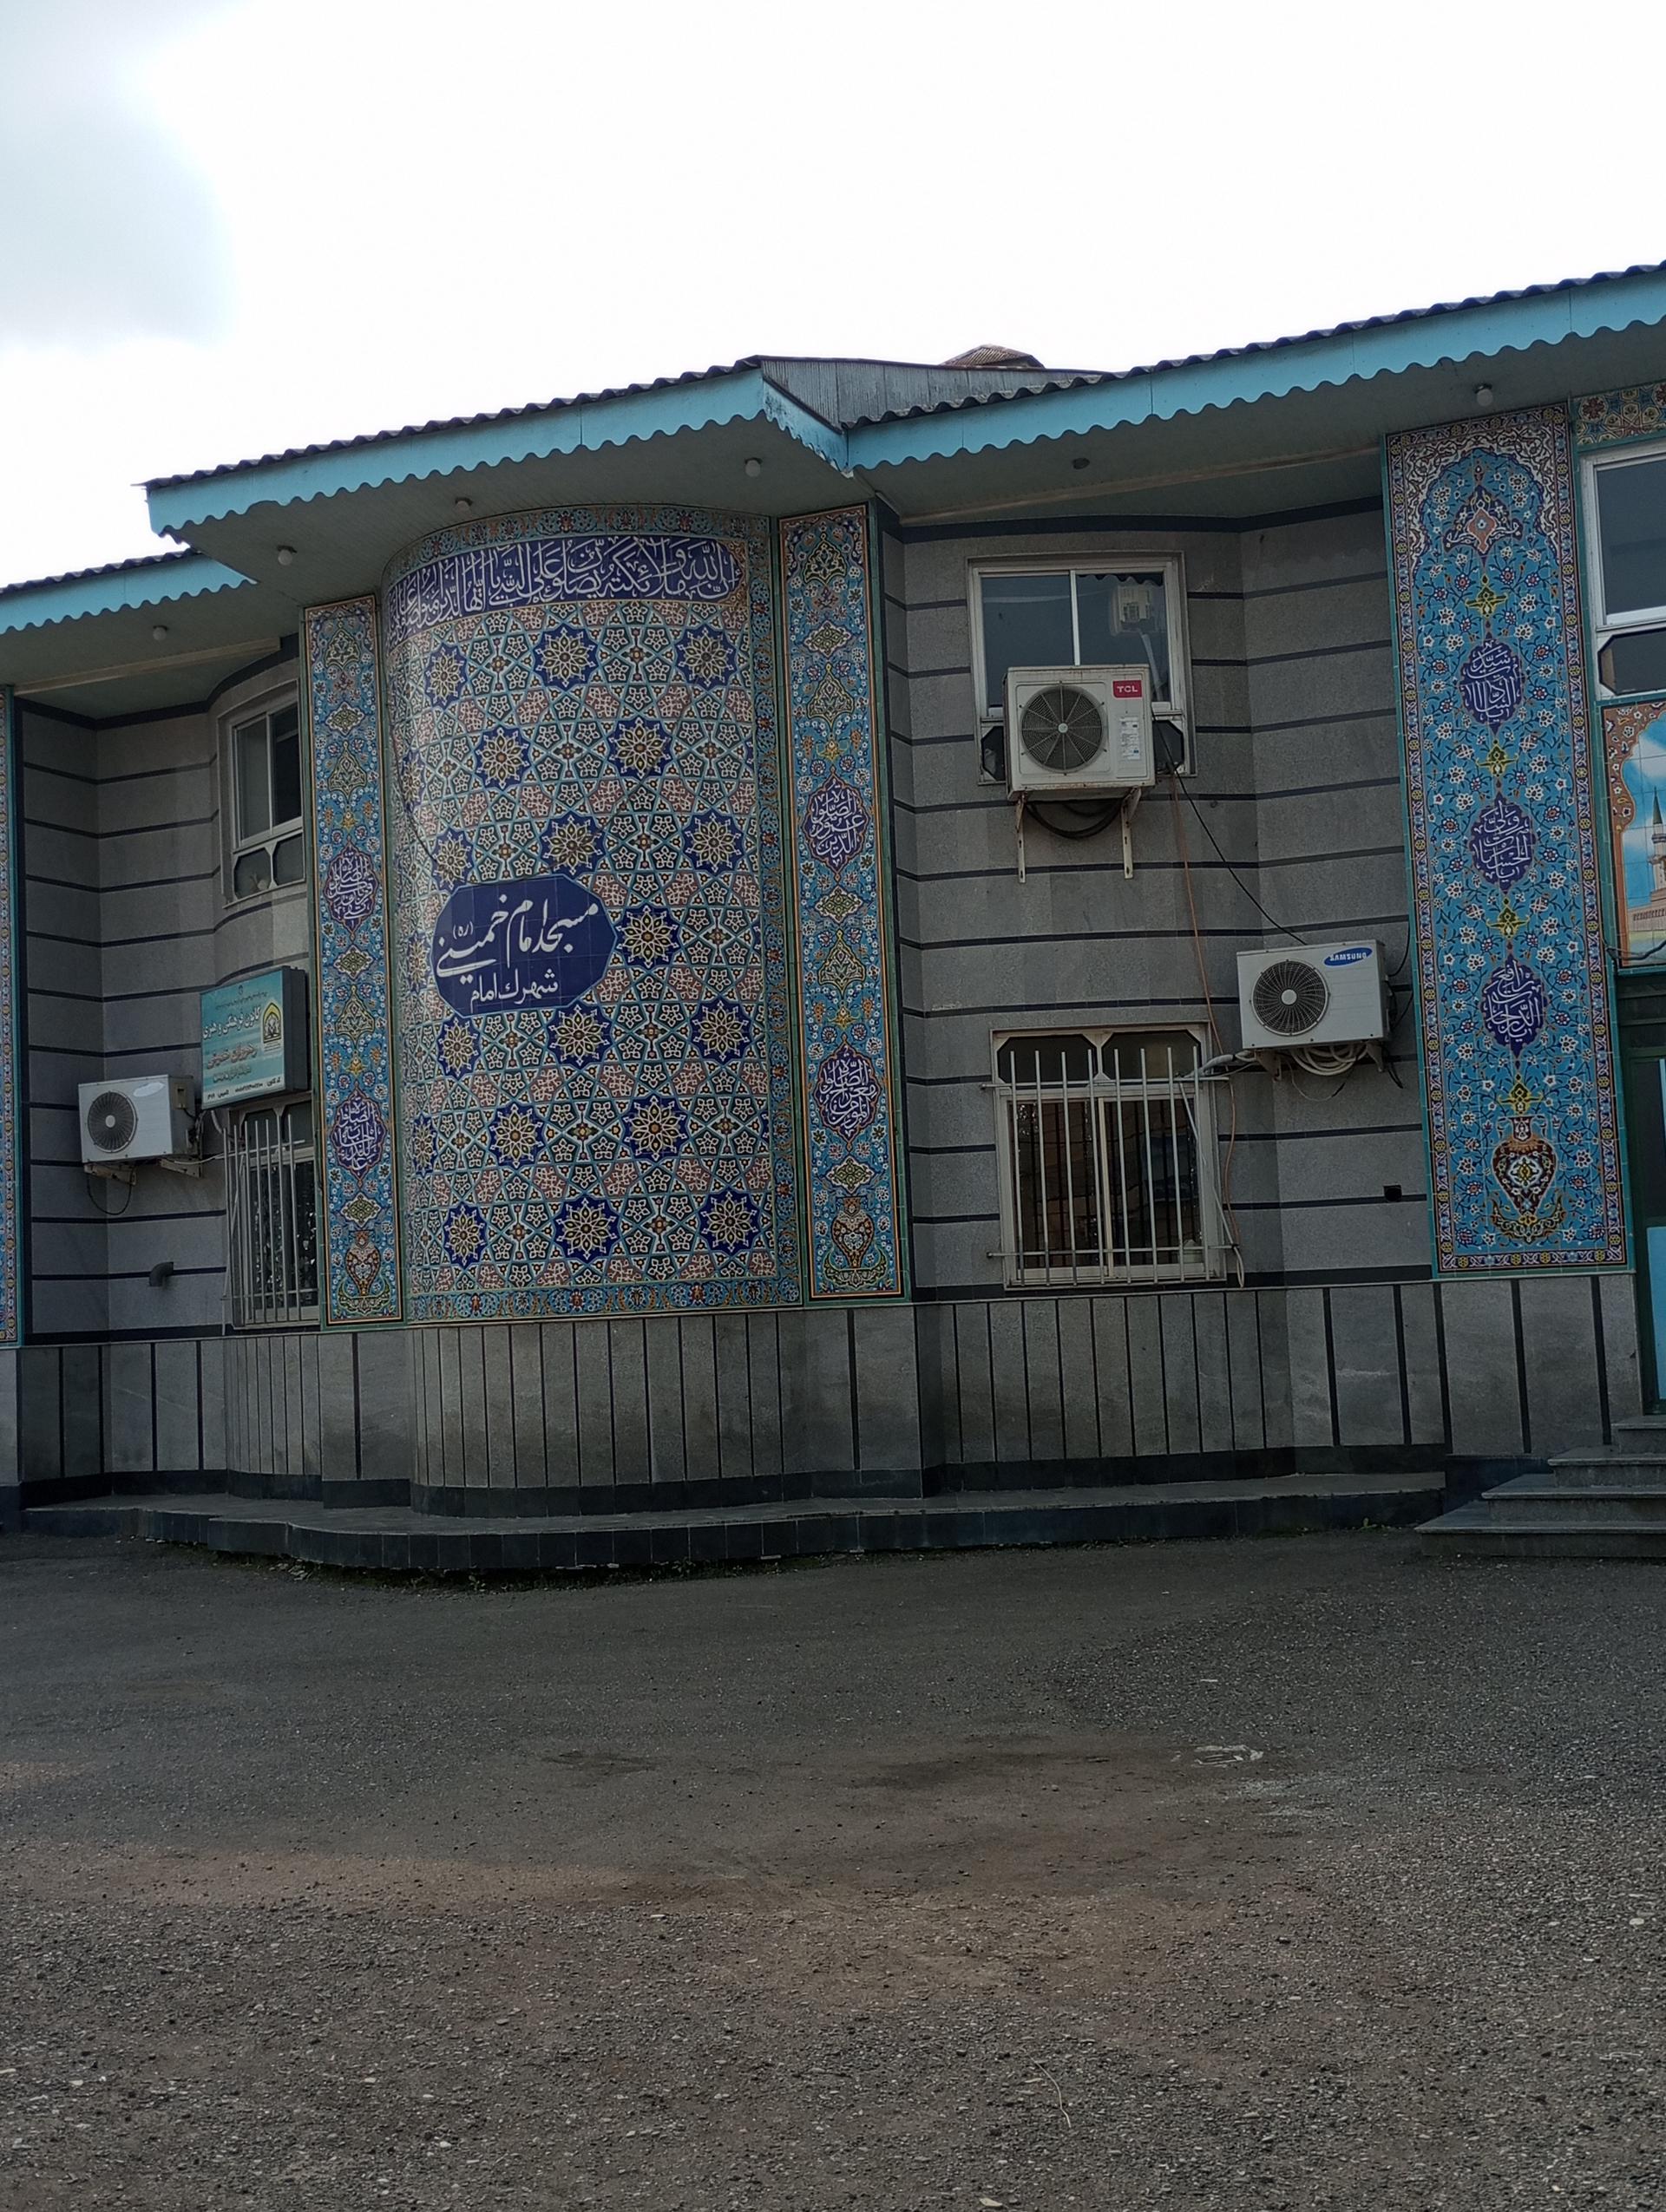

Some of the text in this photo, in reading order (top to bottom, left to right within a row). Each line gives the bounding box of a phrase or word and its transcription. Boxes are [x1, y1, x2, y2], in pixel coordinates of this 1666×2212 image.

[507, 898, 548, 969] امام
[532, 902, 600, 953] مسجد
[1329, 952, 1367, 962] SAMSUNG
[469, 972, 497, 1013] امام
